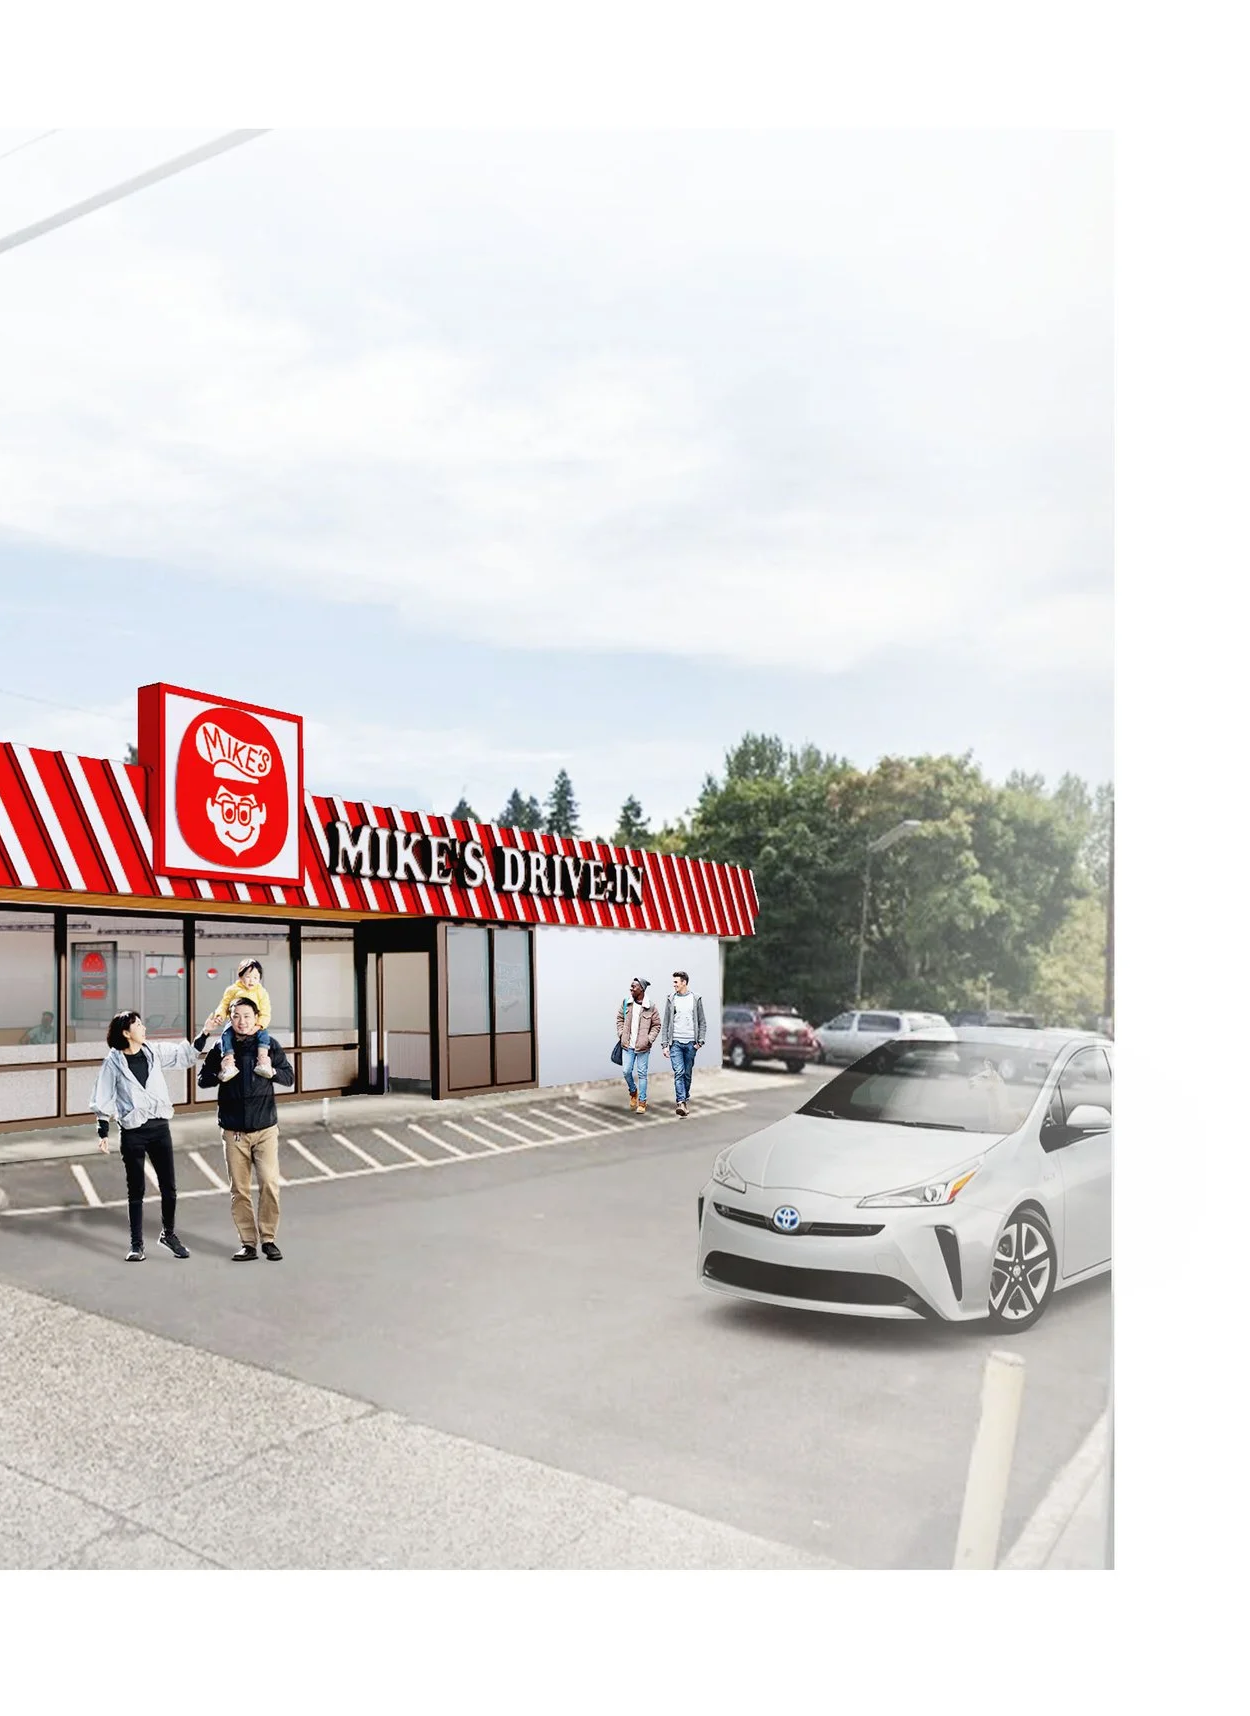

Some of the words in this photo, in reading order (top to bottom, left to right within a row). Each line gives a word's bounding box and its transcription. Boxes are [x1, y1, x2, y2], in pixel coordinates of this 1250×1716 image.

[202, 725, 270, 774] MIKE'S
[334, 820, 486, 888] MIKE'S
[501, 845, 645, 905] DRIVE-IN
